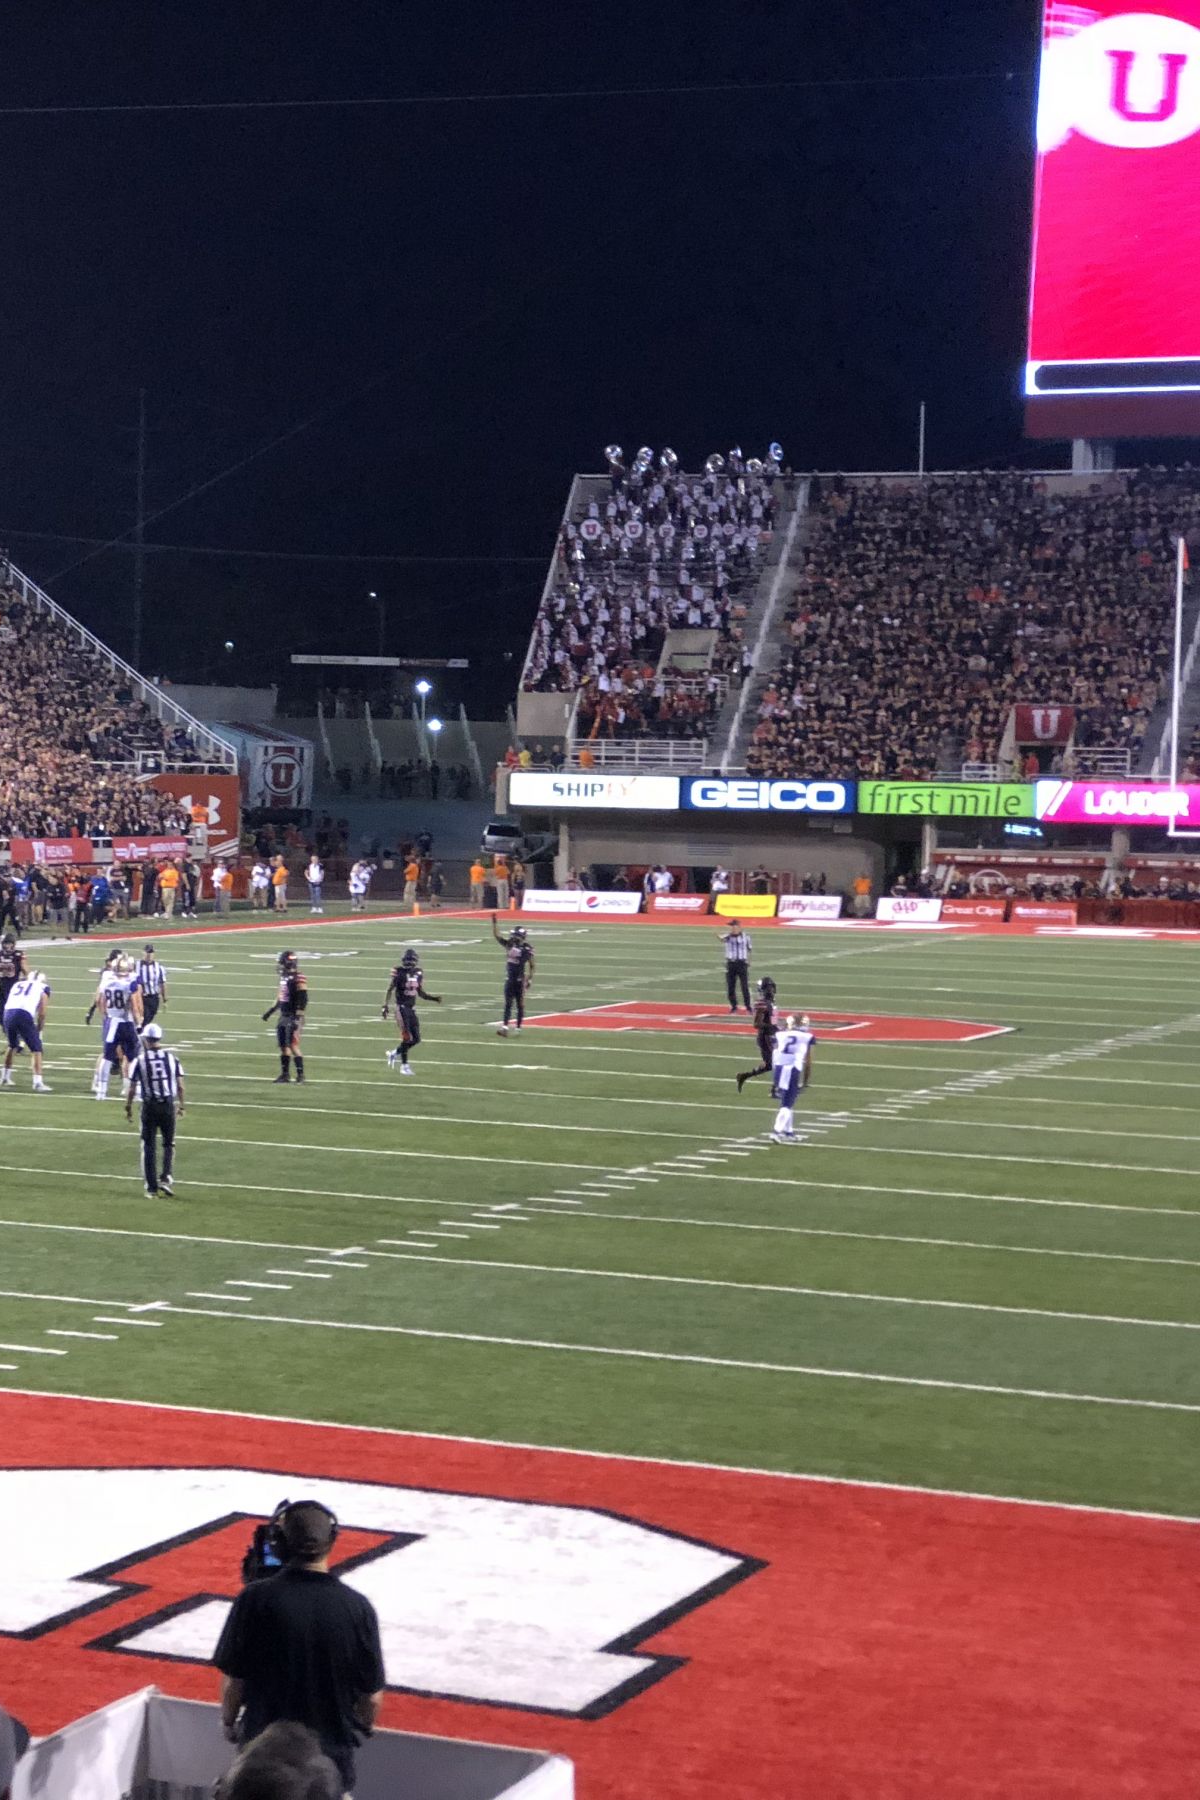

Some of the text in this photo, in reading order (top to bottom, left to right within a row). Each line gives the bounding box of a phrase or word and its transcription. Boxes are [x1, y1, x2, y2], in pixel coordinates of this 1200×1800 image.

[1105, 50, 1188, 122] U
[1031, 709, 1062, 739] U
[271, 763, 296, 789] U
[690, 780, 846, 810] GEICO
[868, 785, 1022, 817] first mile
[780, 899, 807, 912] jiffy
[13, 982, 34, 996] 51
[104, 989, 126, 1010] 88
[781, 1036, 798, 1054] 2
[149, 1059, 168, 1079] R
